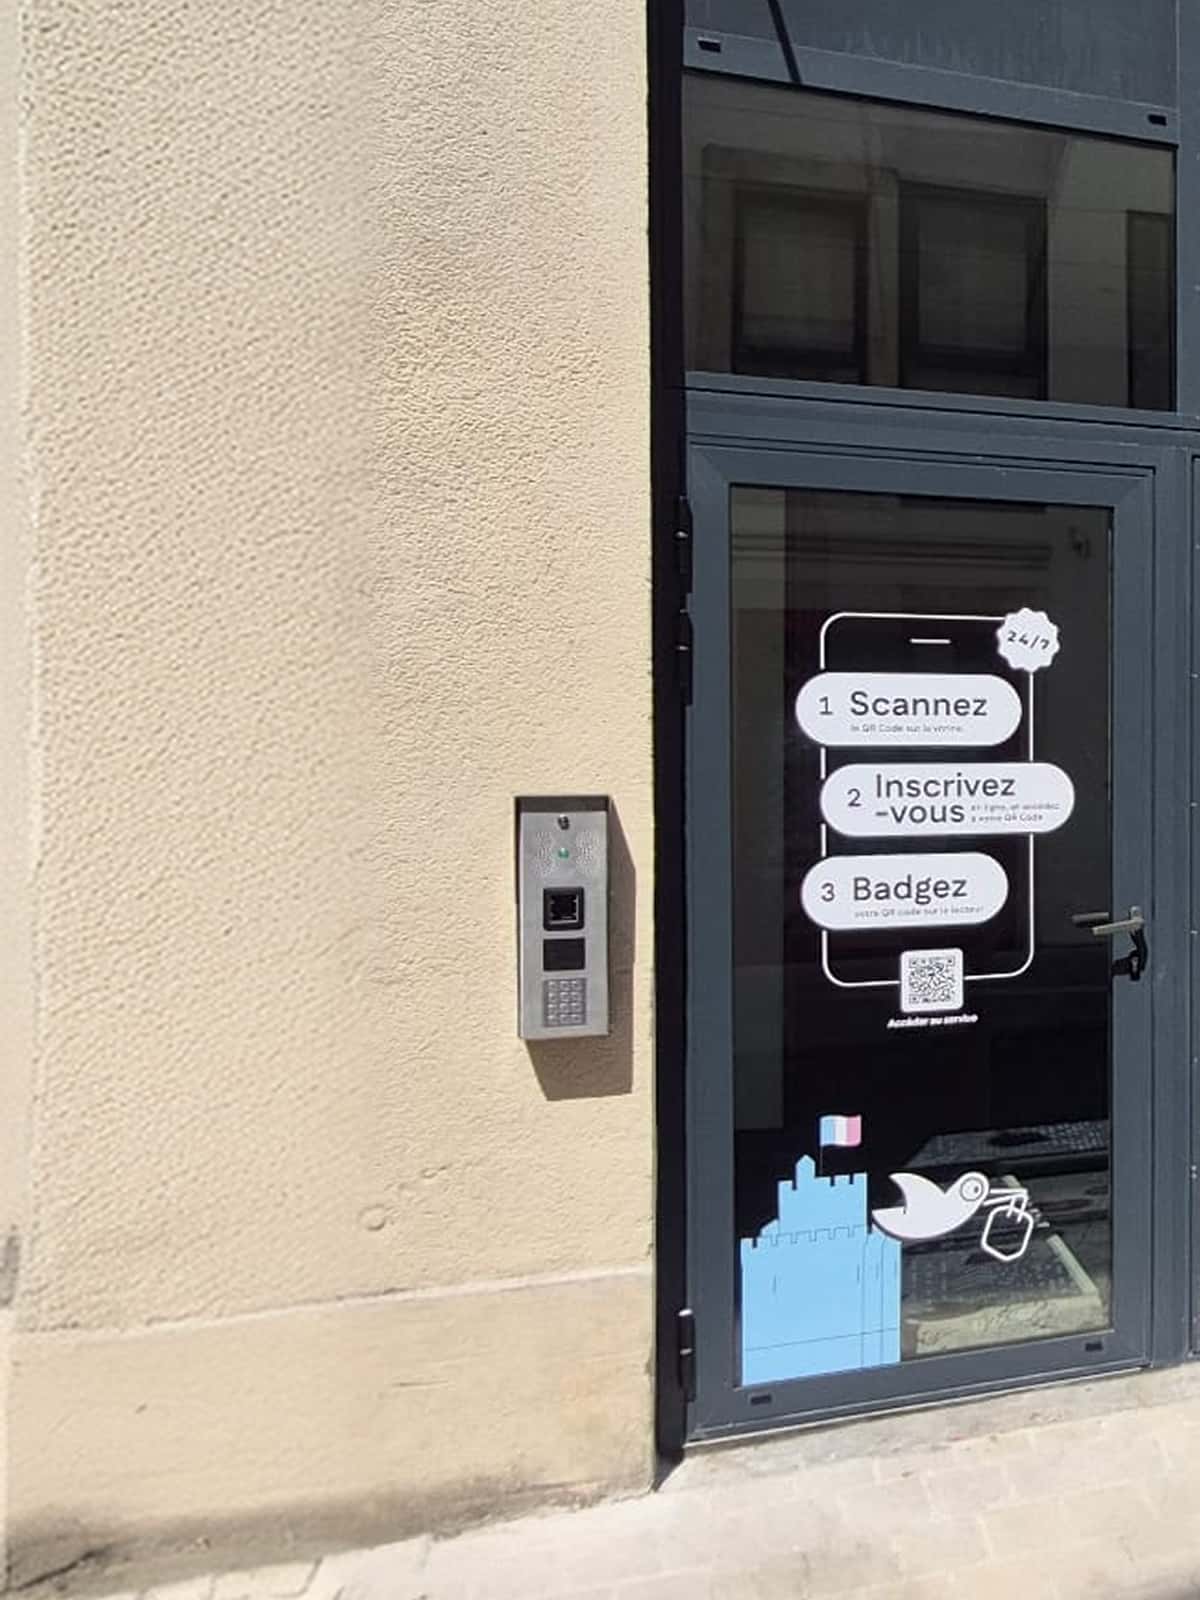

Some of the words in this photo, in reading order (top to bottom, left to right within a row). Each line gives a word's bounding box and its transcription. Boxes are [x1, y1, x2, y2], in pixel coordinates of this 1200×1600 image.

[1007, 630, 1050, 650] 24/7
[819, 696, 833, 715] 1
[850, 690, 987, 717] Scannez
[879, 723, 903, 733] Code
[847, 788, 861, 807] 2
[876, 772, 1015, 798] Inscrivez
[876, 804, 965, 823] -vous
[821, 882, 835, 902] 3
[852, 874, 968, 905] Badgez
